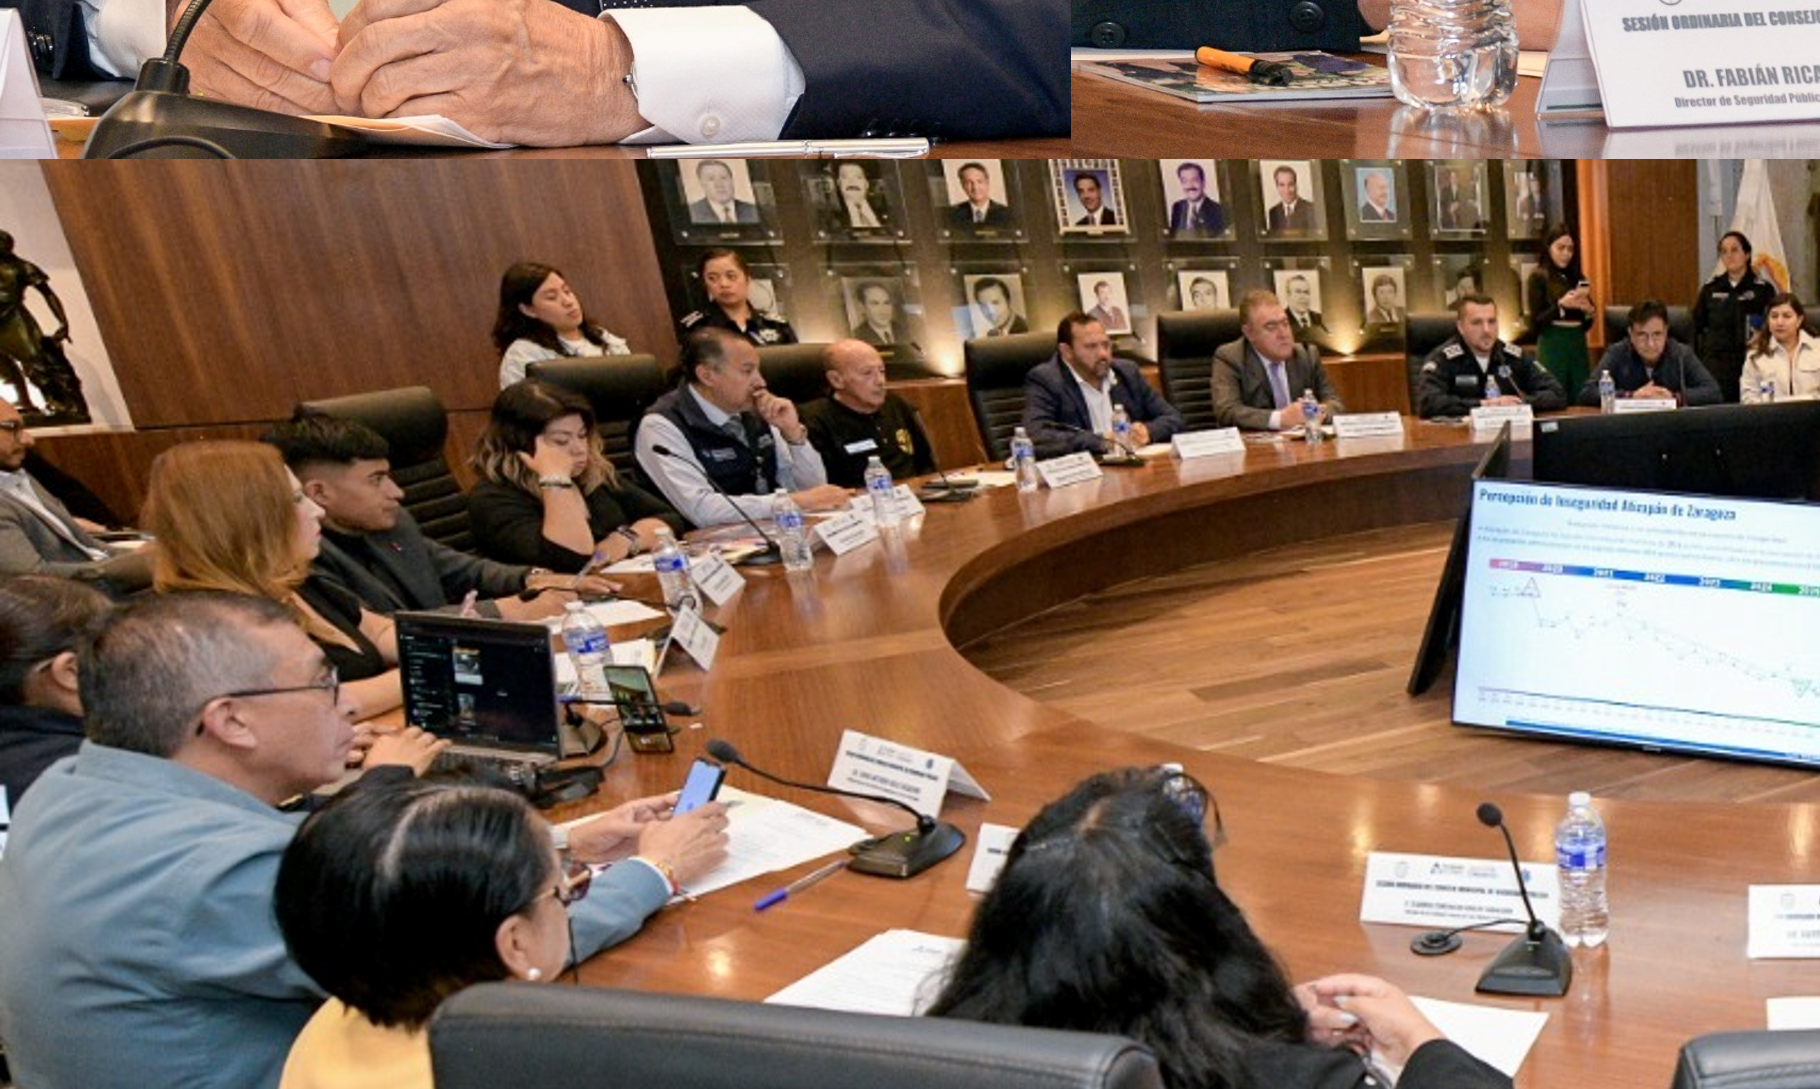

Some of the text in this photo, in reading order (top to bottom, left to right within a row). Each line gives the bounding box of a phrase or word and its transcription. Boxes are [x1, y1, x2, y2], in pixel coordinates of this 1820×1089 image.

[1622, 13, 1669, 32] SESIÓN
[1672, 13, 1742, 30] ORDINARIA
[1743, 12, 1767, 27] DEL
[1683, 69, 1714, 88] DR.
[1715, 64, 1779, 87] FABIÁN
[1675, 96, 1717, 108] Director
[1719, 95, 1732, 106] de
[1734, 92, 1787, 107] Seguridad
[1670, 503, 1683, 517] de
[1686, 504, 1737, 522] Zaragoza
